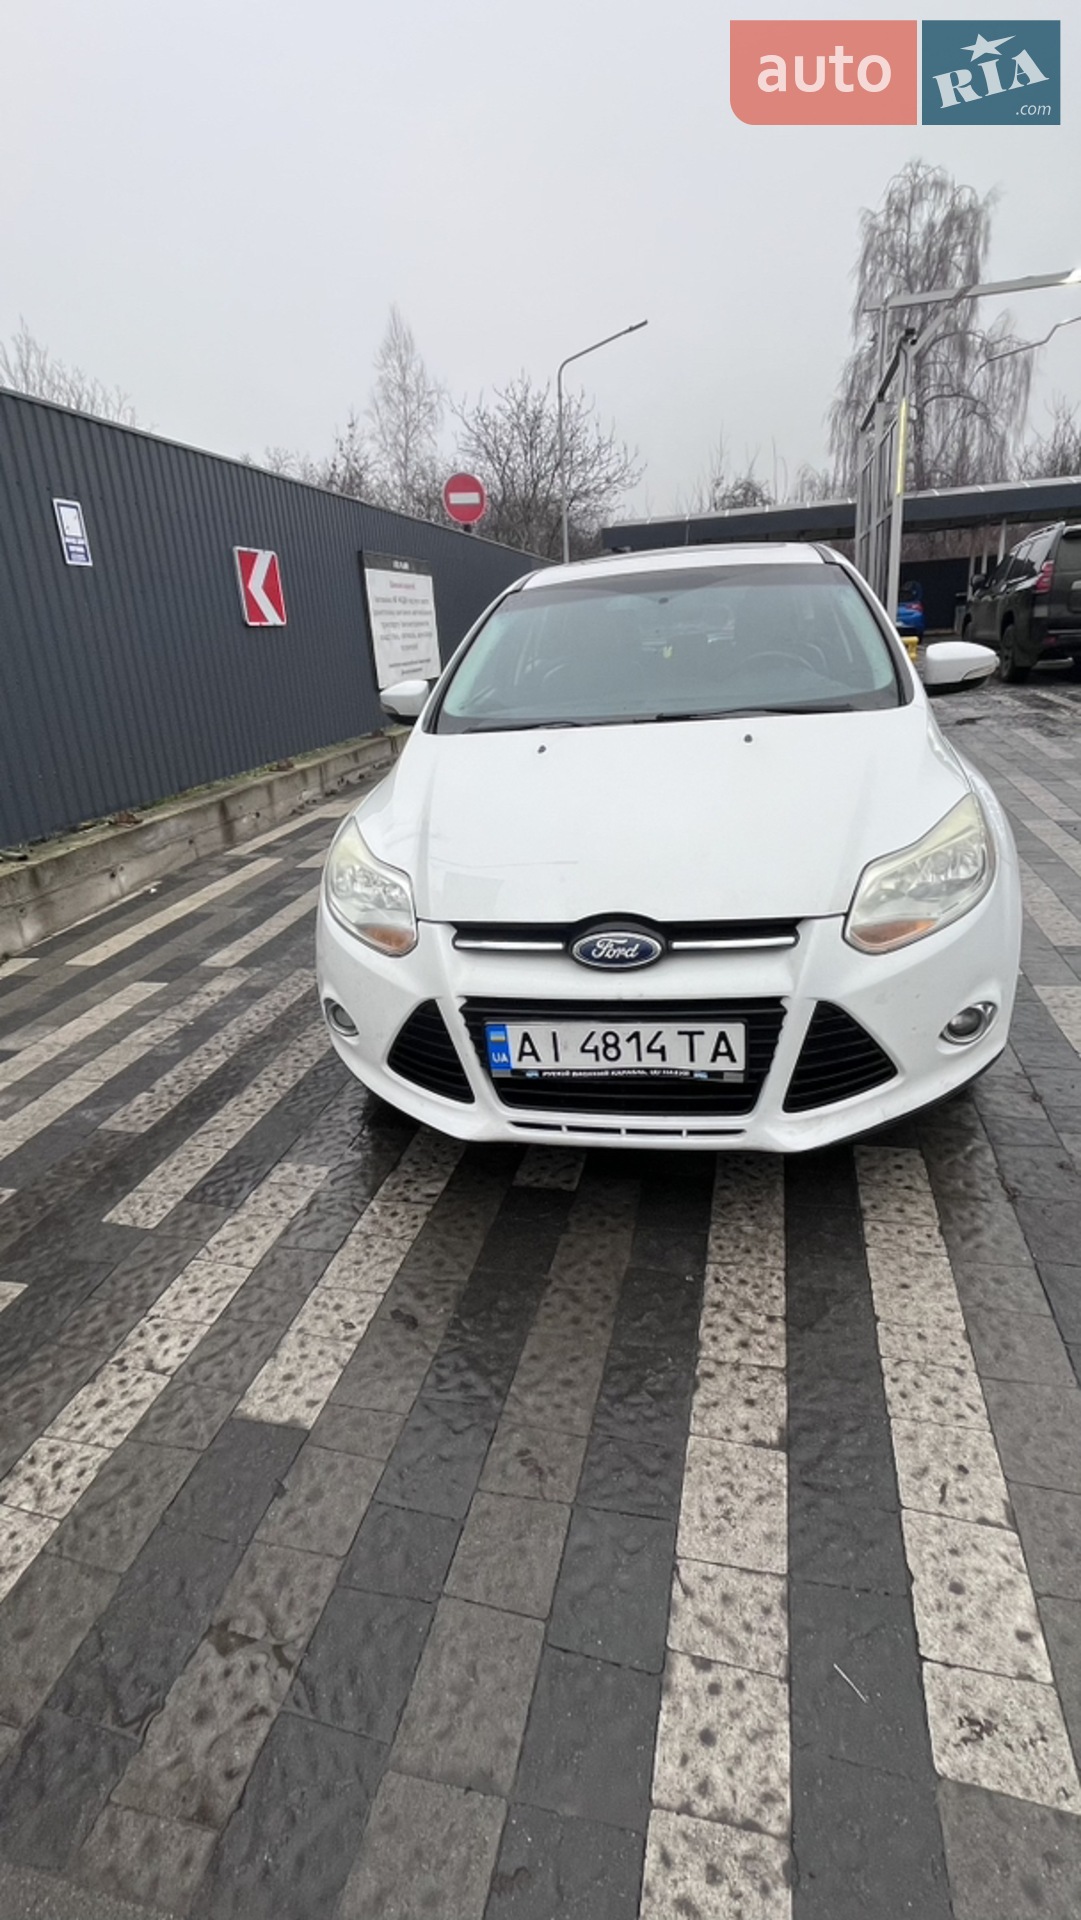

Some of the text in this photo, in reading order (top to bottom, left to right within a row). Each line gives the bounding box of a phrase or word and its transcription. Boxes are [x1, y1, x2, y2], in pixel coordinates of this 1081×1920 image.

[591, 938, 640, 959] Ford
[517, 1031, 737, 1063] AI 4814 TA
[492, 1052, 509, 1064] UA
